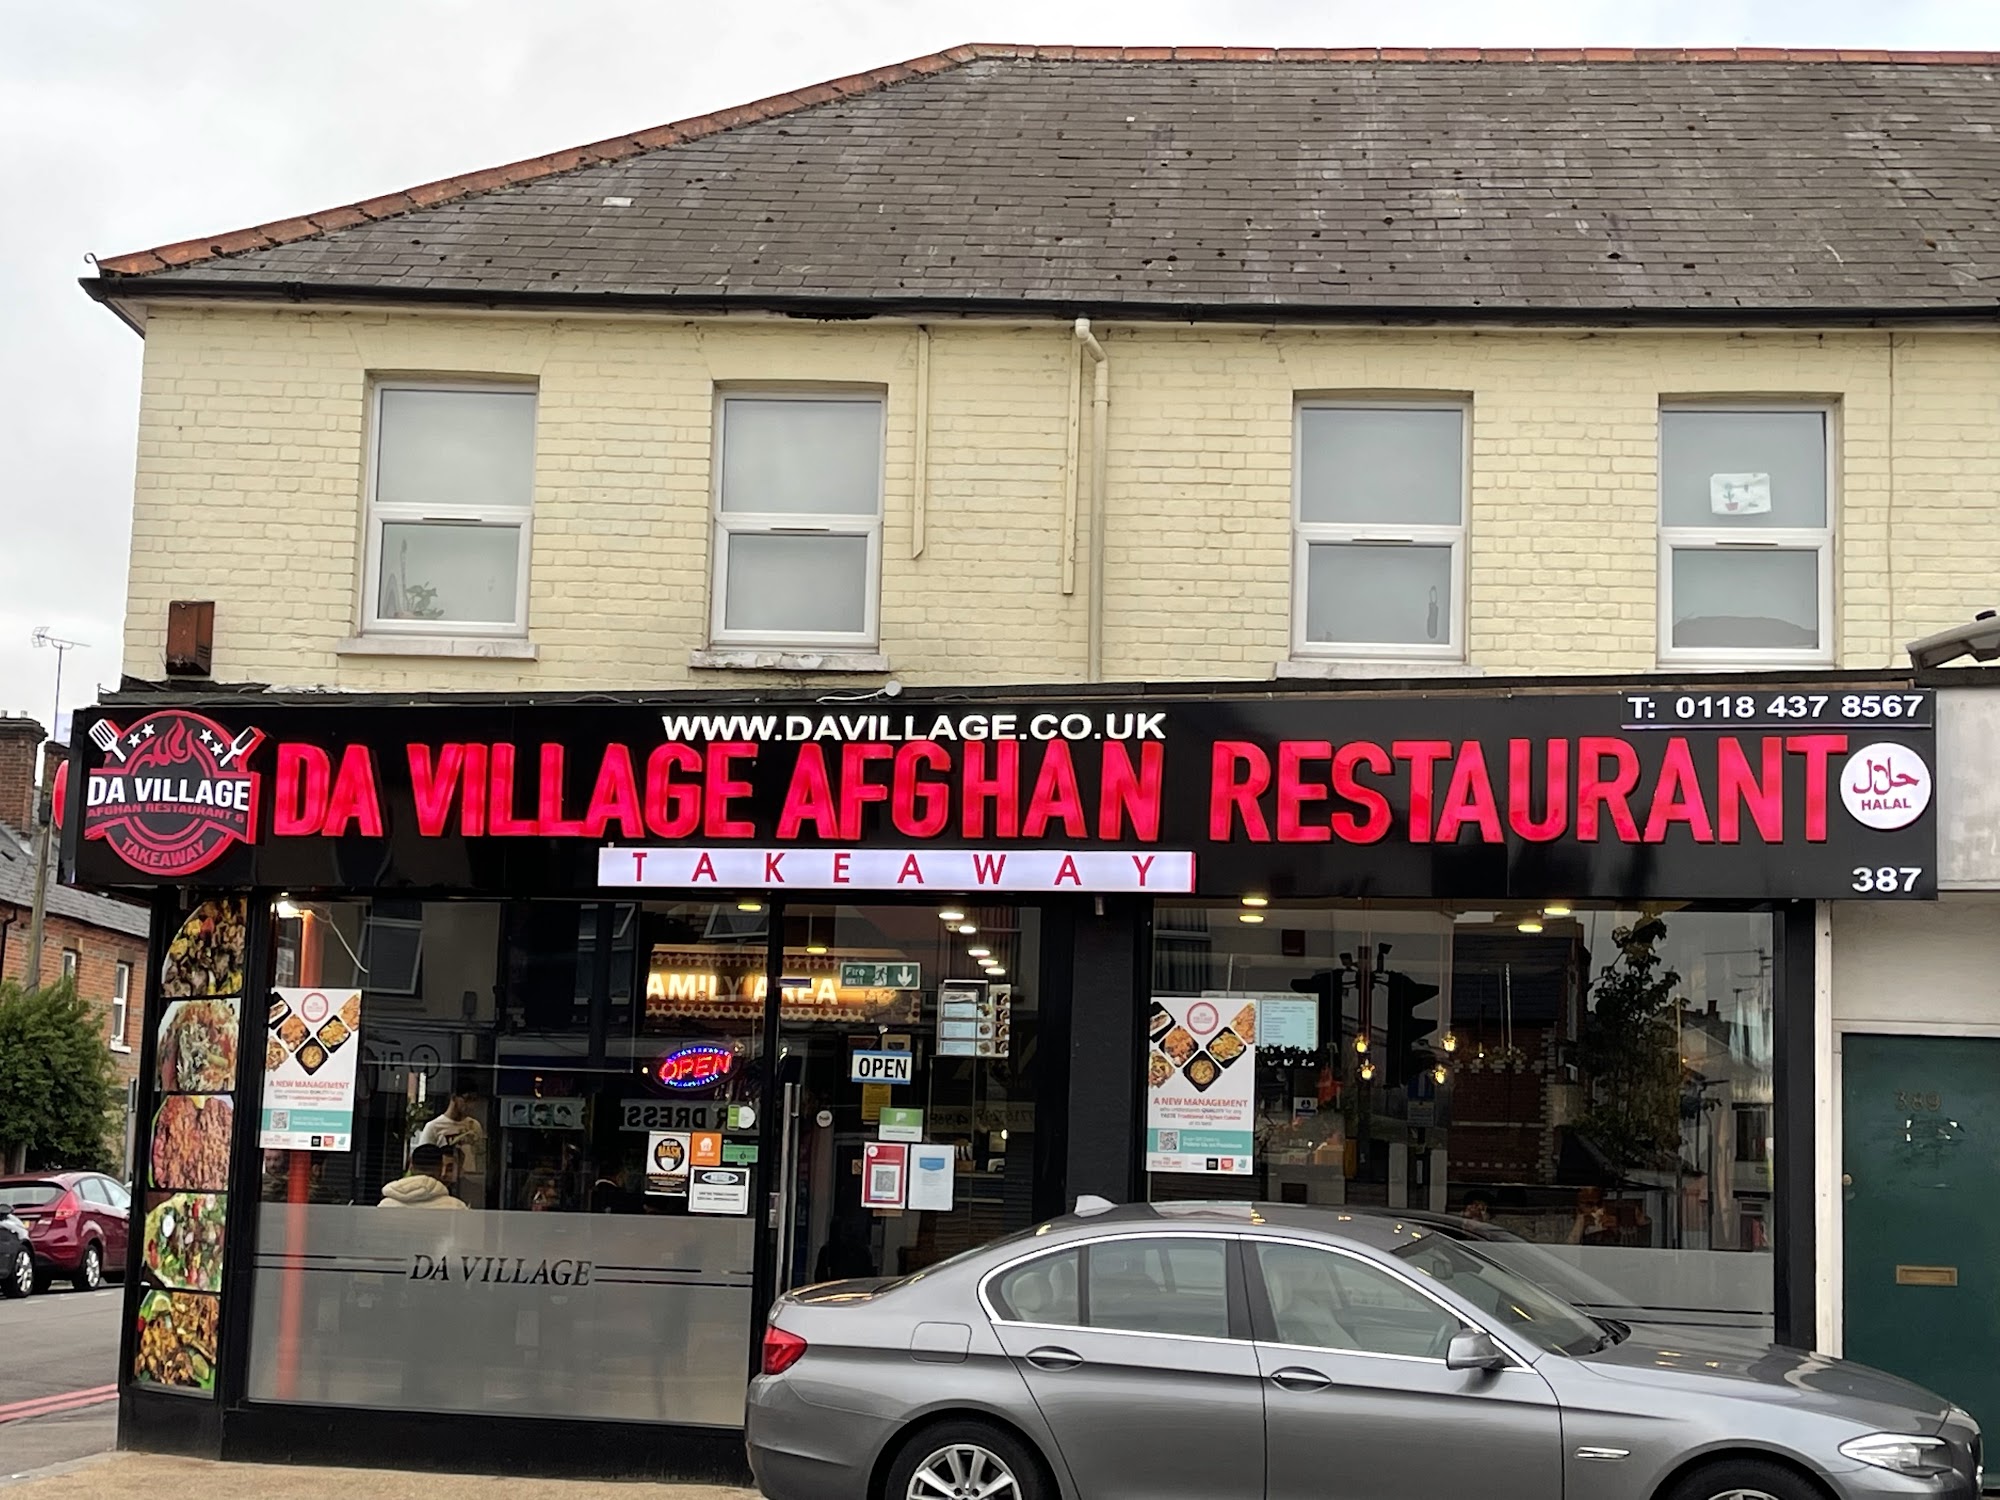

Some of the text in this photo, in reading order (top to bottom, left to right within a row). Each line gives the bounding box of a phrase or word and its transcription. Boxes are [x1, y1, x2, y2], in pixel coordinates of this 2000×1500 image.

[1628, 694, 1923, 720] T: 0118 437 8567
[661, 712, 1167, 742] WWW.DAVILLAGE.CO.UK
[273, 735, 1848, 844] DA VILLAGE AFGHAN RESTAURANT
[1852, 757, 1920, 796] حلال
[86, 776, 252, 812] DA VILLAGE
[1861, 798, 1912, 811] HALAL
[87, 803, 142, 818] AFGHAN
[145, 803, 231, 820] RESTAURANT
[122, 837, 205, 867] TAKEAWAY
[632, 851, 1157, 887] TAKEAWAY
[1851, 867, 1922, 892] 387
[845, 966, 866, 977] Fire
[646, 973, 744, 1002] AMILY
[659, 1053, 732, 1081] OPEN
[858, 1057, 908, 1079] OPEN
[1161, 1097, 1182, 1106] NEW
[1183, 1098, 1248, 1107] MANAGEMENT
[409, 1254, 593, 1287] DA VILLAGE
